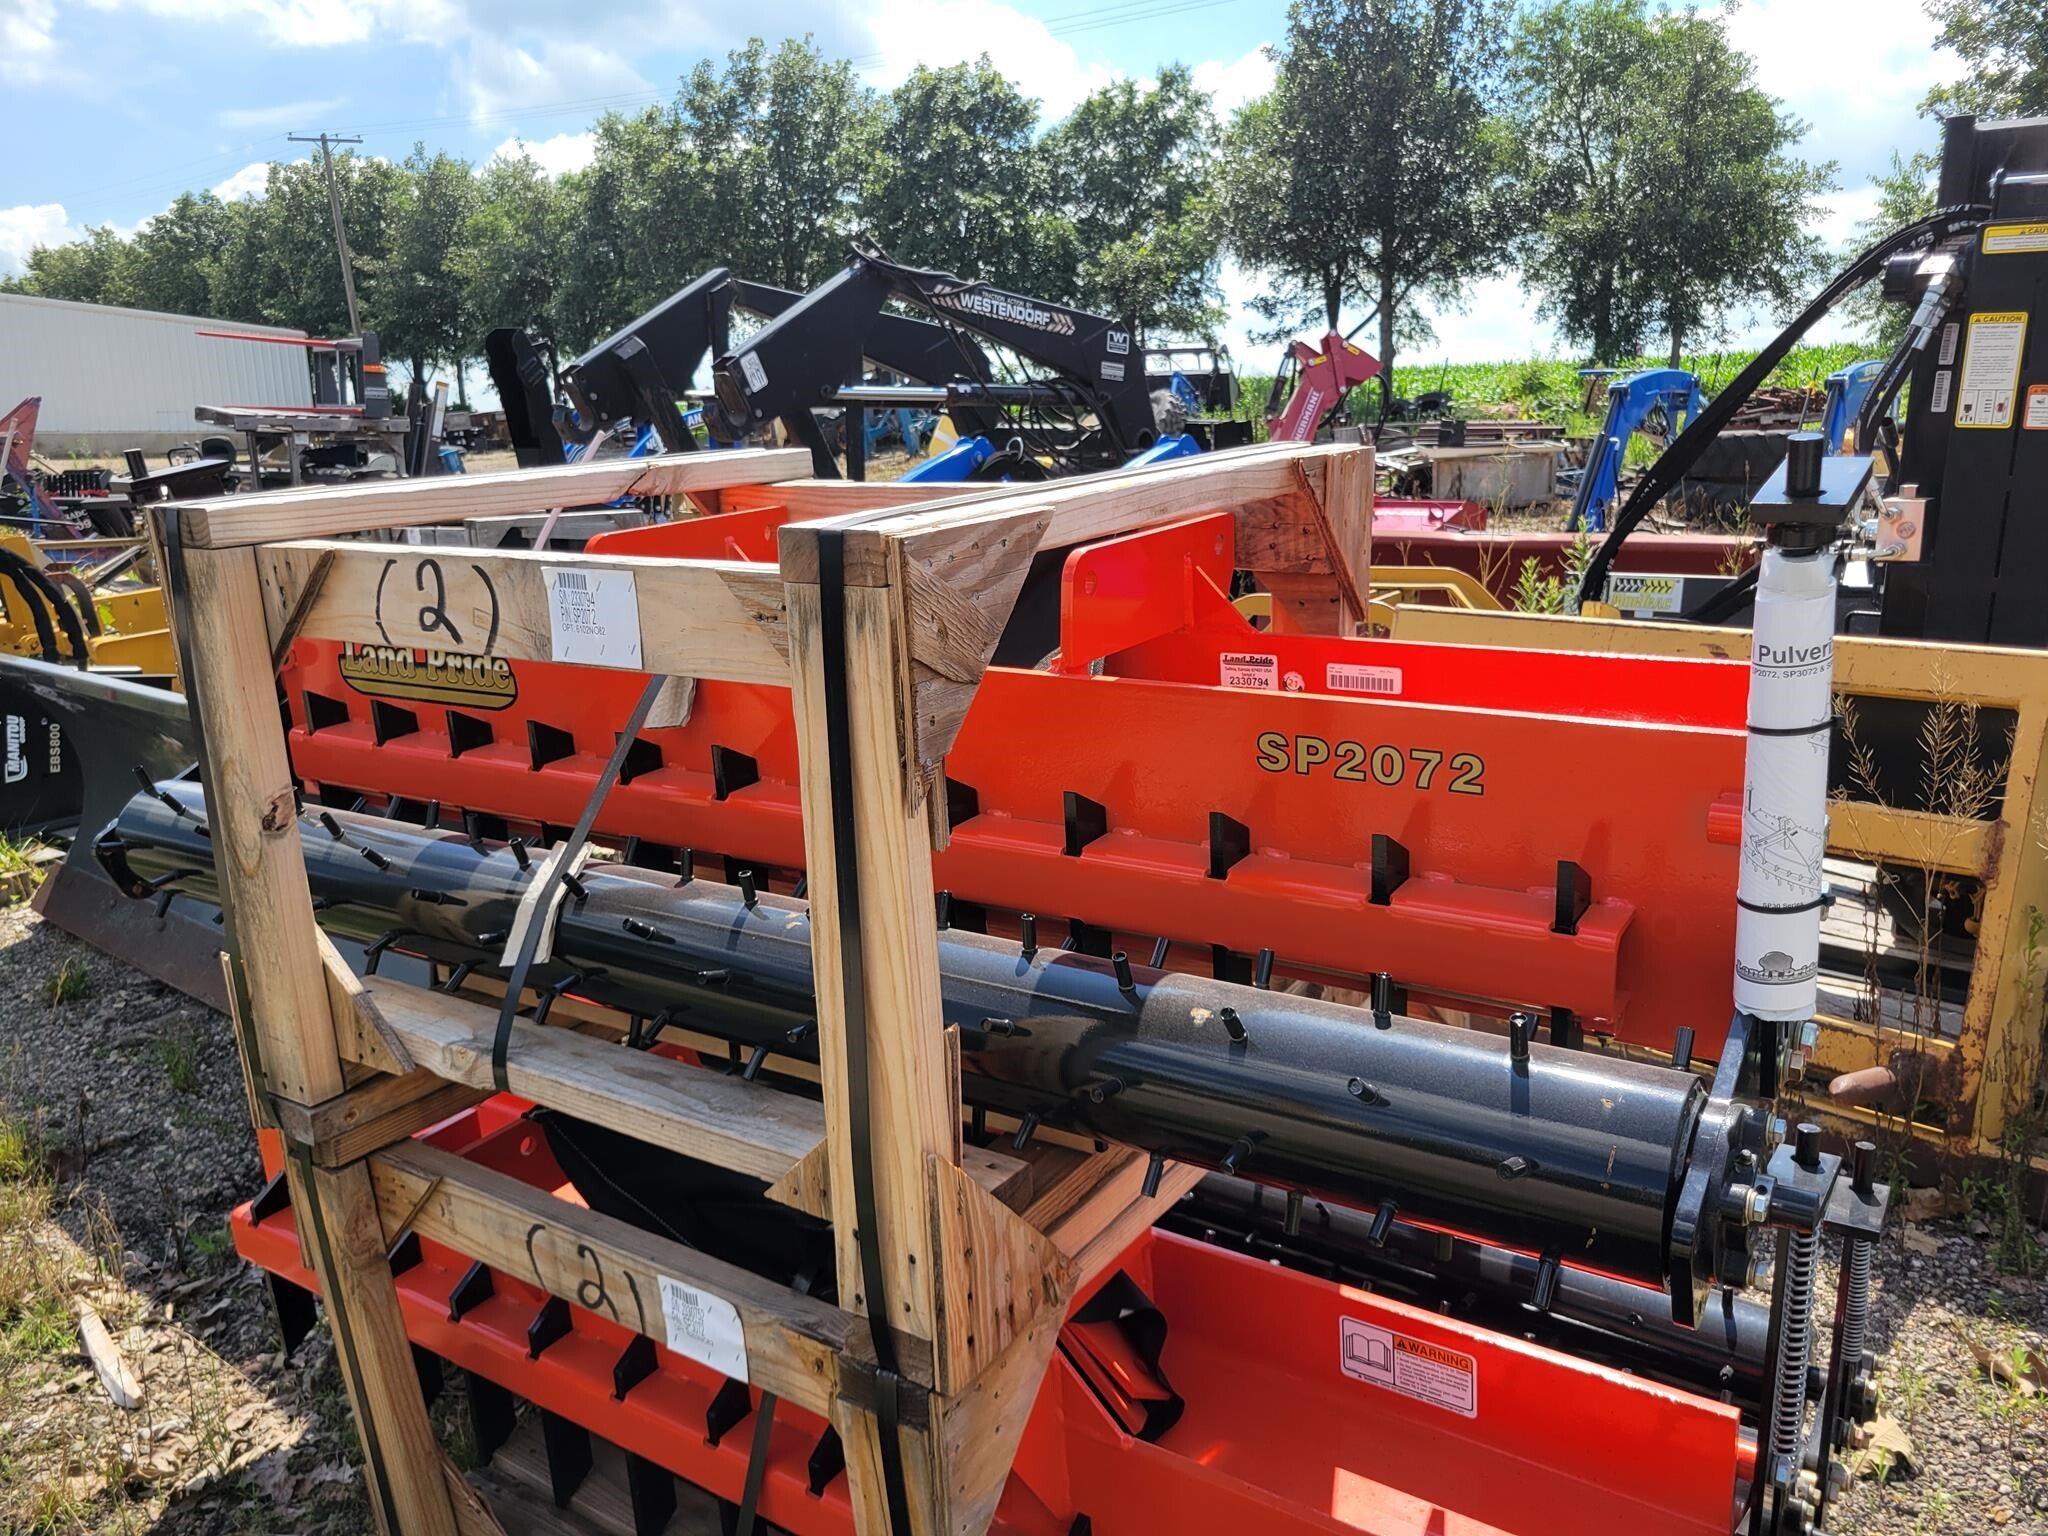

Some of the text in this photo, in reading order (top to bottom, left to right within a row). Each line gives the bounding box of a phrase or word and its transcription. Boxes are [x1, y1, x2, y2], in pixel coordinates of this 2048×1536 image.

[959, 292, 1051, 326] WESTENDORF
[1983, 315, 2023, 323] CAUTION
[573, 607, 597, 625] SP2072
[344, 641, 511, 690] Land Pride
[1222, 654, 1275, 666] Land Pride
[1783, 667, 1818, 679] SP3072
[1229, 676, 1269, 687] 2330794
[6, 714, 20, 773] MANITOU
[49, 723, 61, 774] EBS800
[1256, 731, 1485, 796] SP2072
[1408, 1343, 1470, 1370] WARNING
